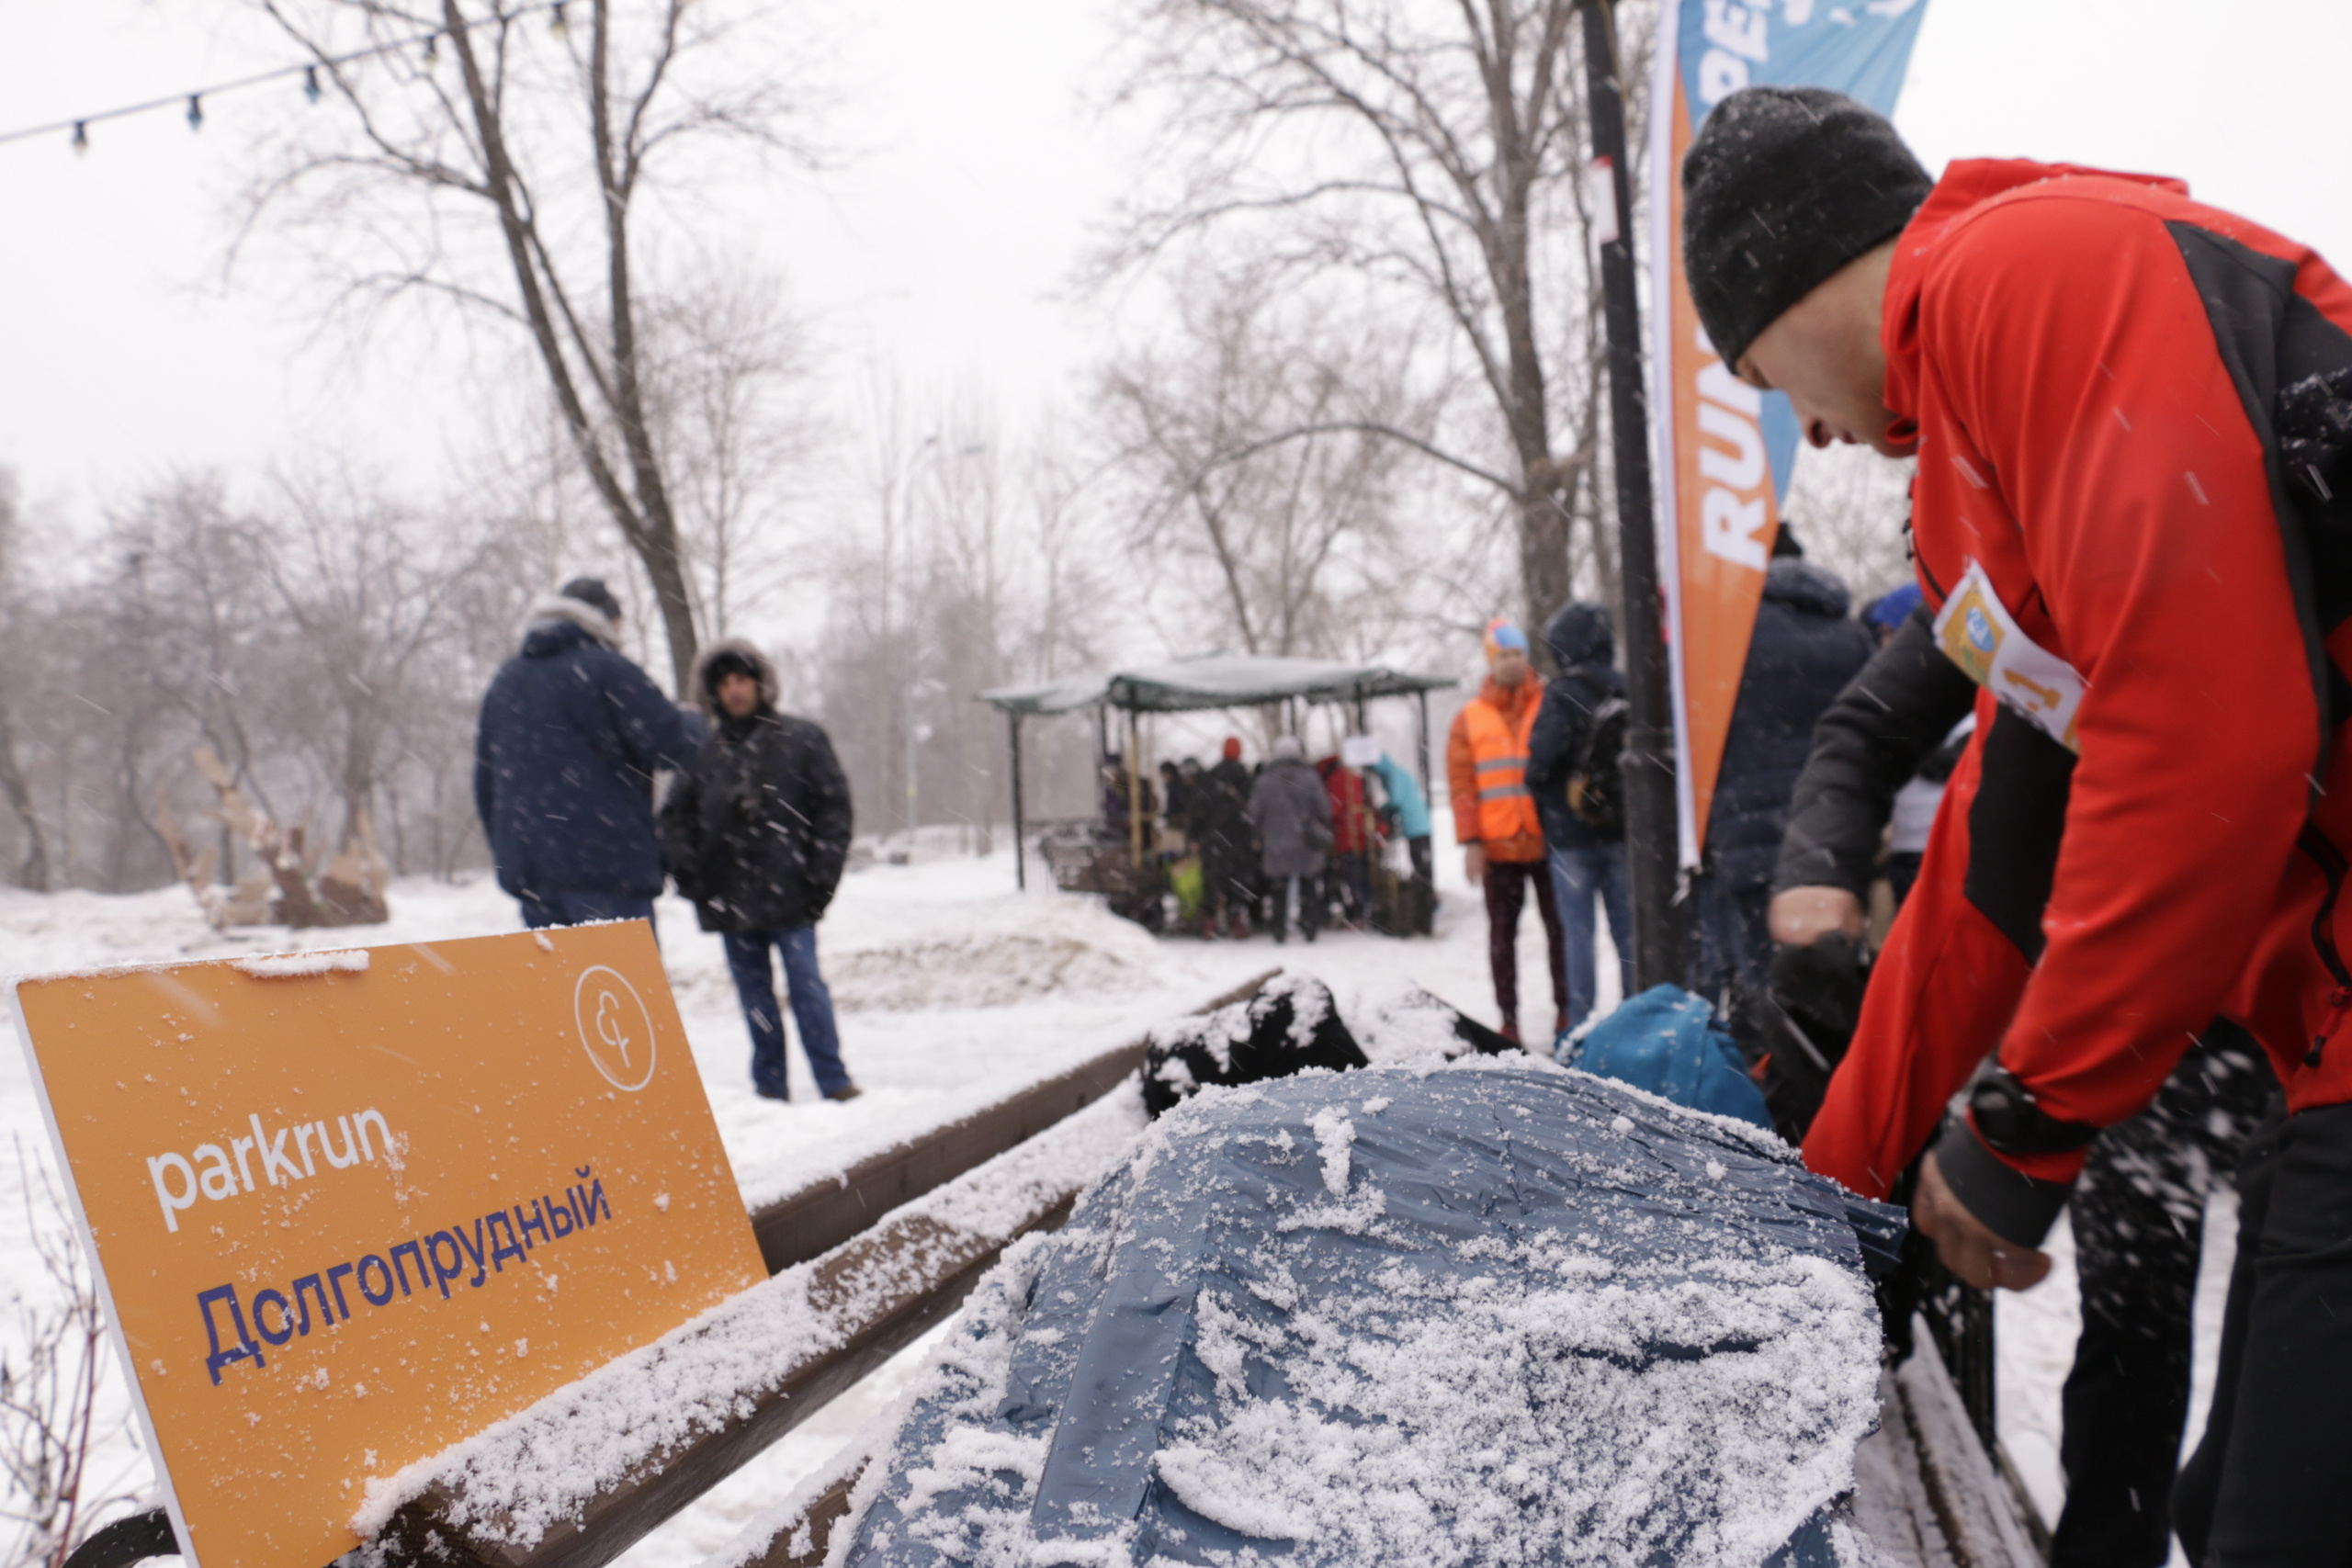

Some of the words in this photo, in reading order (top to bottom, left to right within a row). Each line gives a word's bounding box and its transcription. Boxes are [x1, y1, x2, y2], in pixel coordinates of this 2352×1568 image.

[2003, 667, 2062, 712] 1
[146, 1109, 395, 1233] parkrun
[197, 1165, 612, 1386] Долгопрудный
